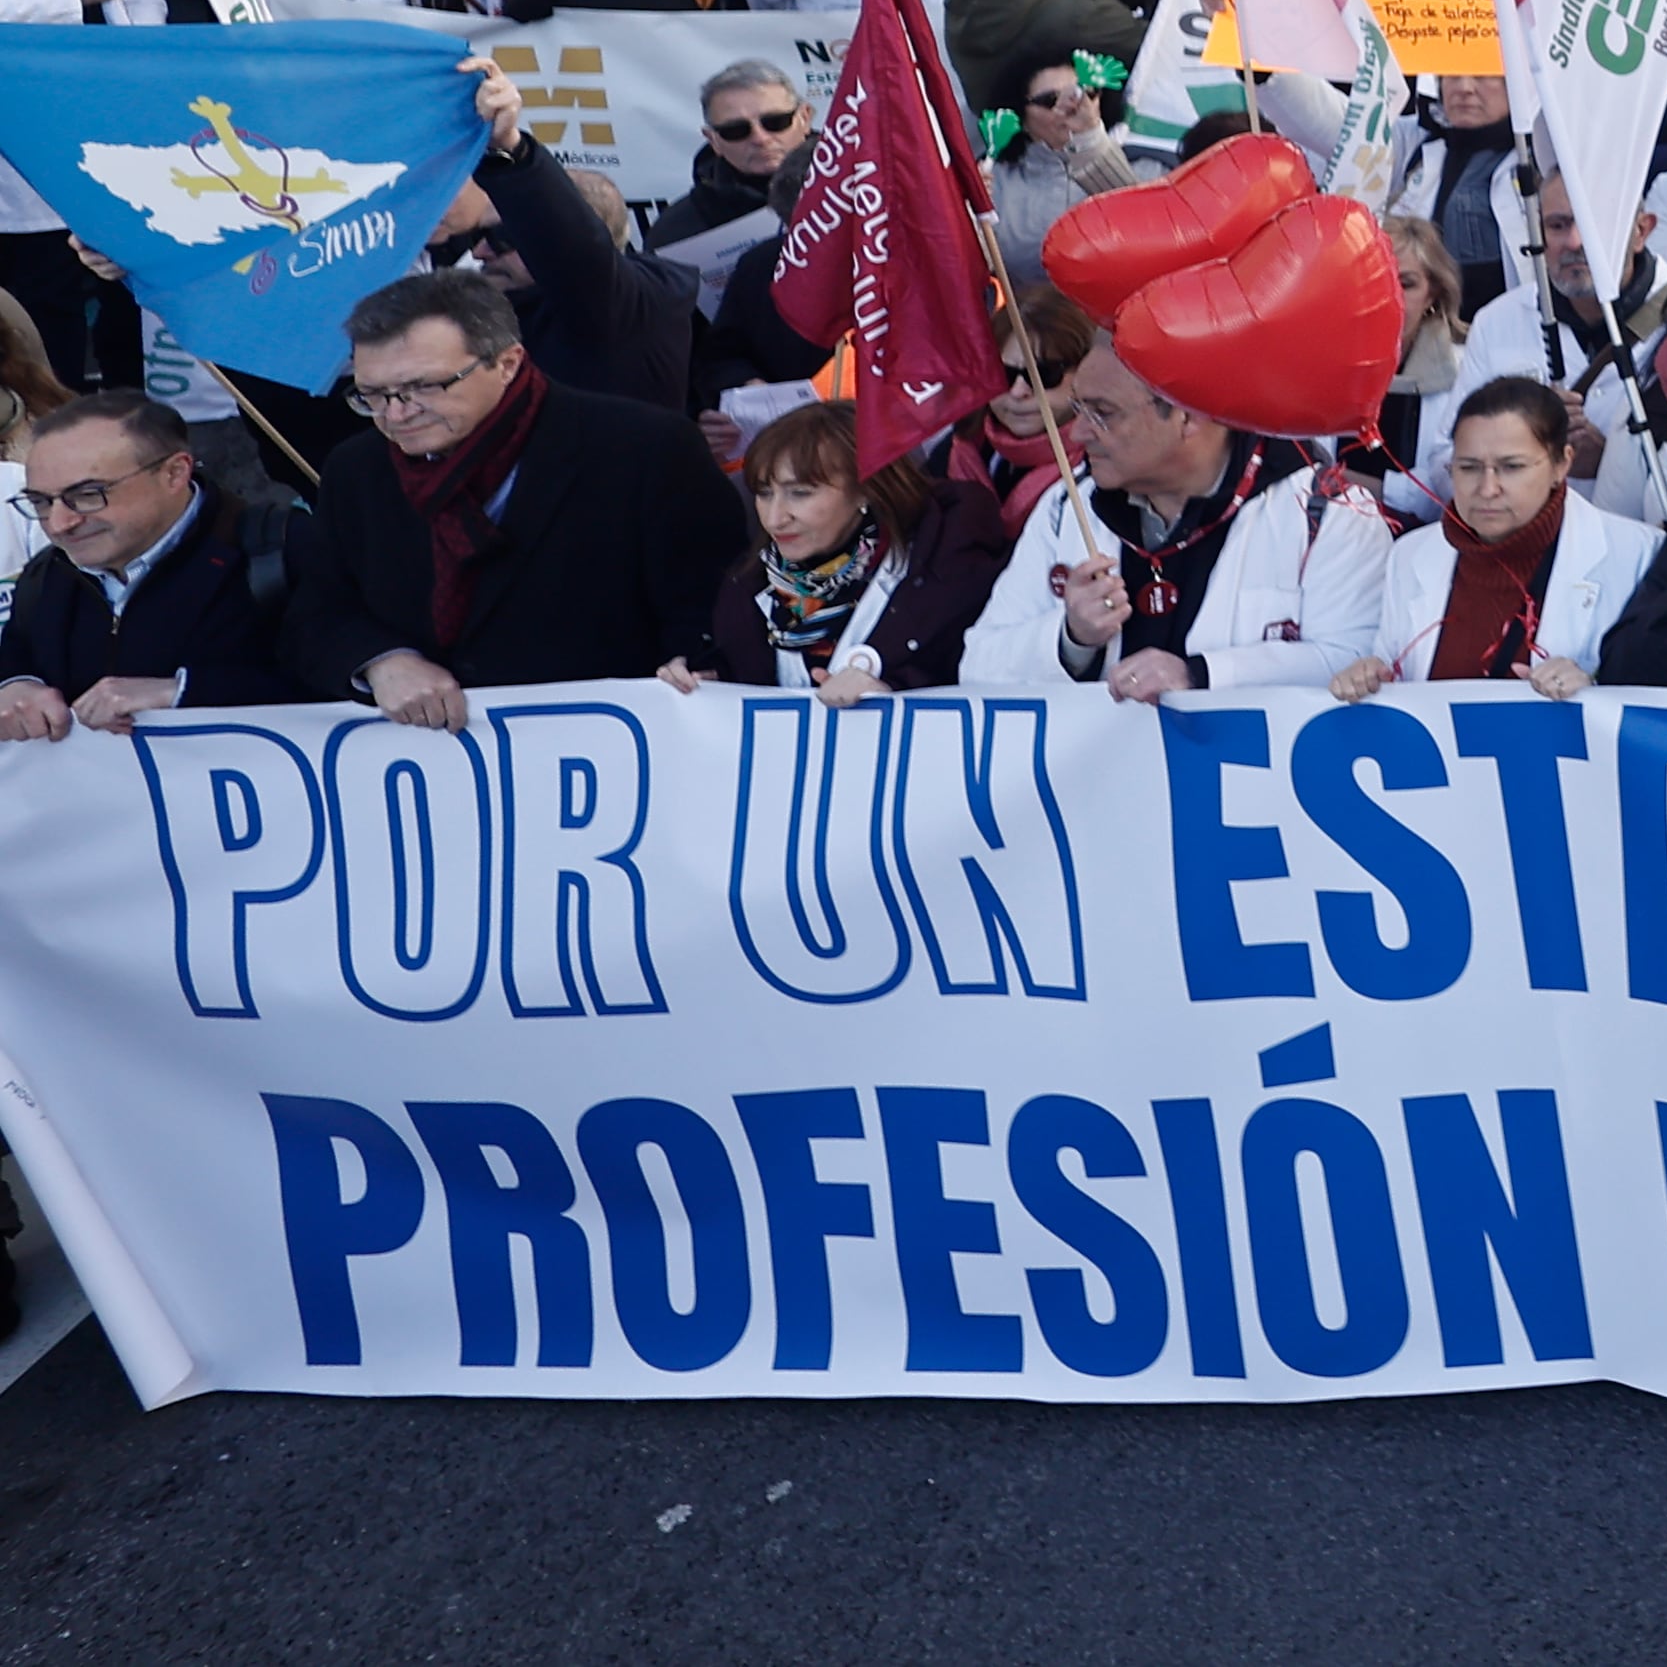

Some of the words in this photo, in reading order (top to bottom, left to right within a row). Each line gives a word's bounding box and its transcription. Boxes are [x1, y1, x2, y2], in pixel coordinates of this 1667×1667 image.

[1384, 5, 1413, 26] Fuga
[1420, 5, 1436, 19] de
[1386, 24, 1442, 46] Desgaste
[555, 152, 621, 168] Médicos
[137, 703, 667, 1019] POR
[730, 699, 1088, 1005] UN
[262, 1021, 1593, 1380] PROFESIÓN
